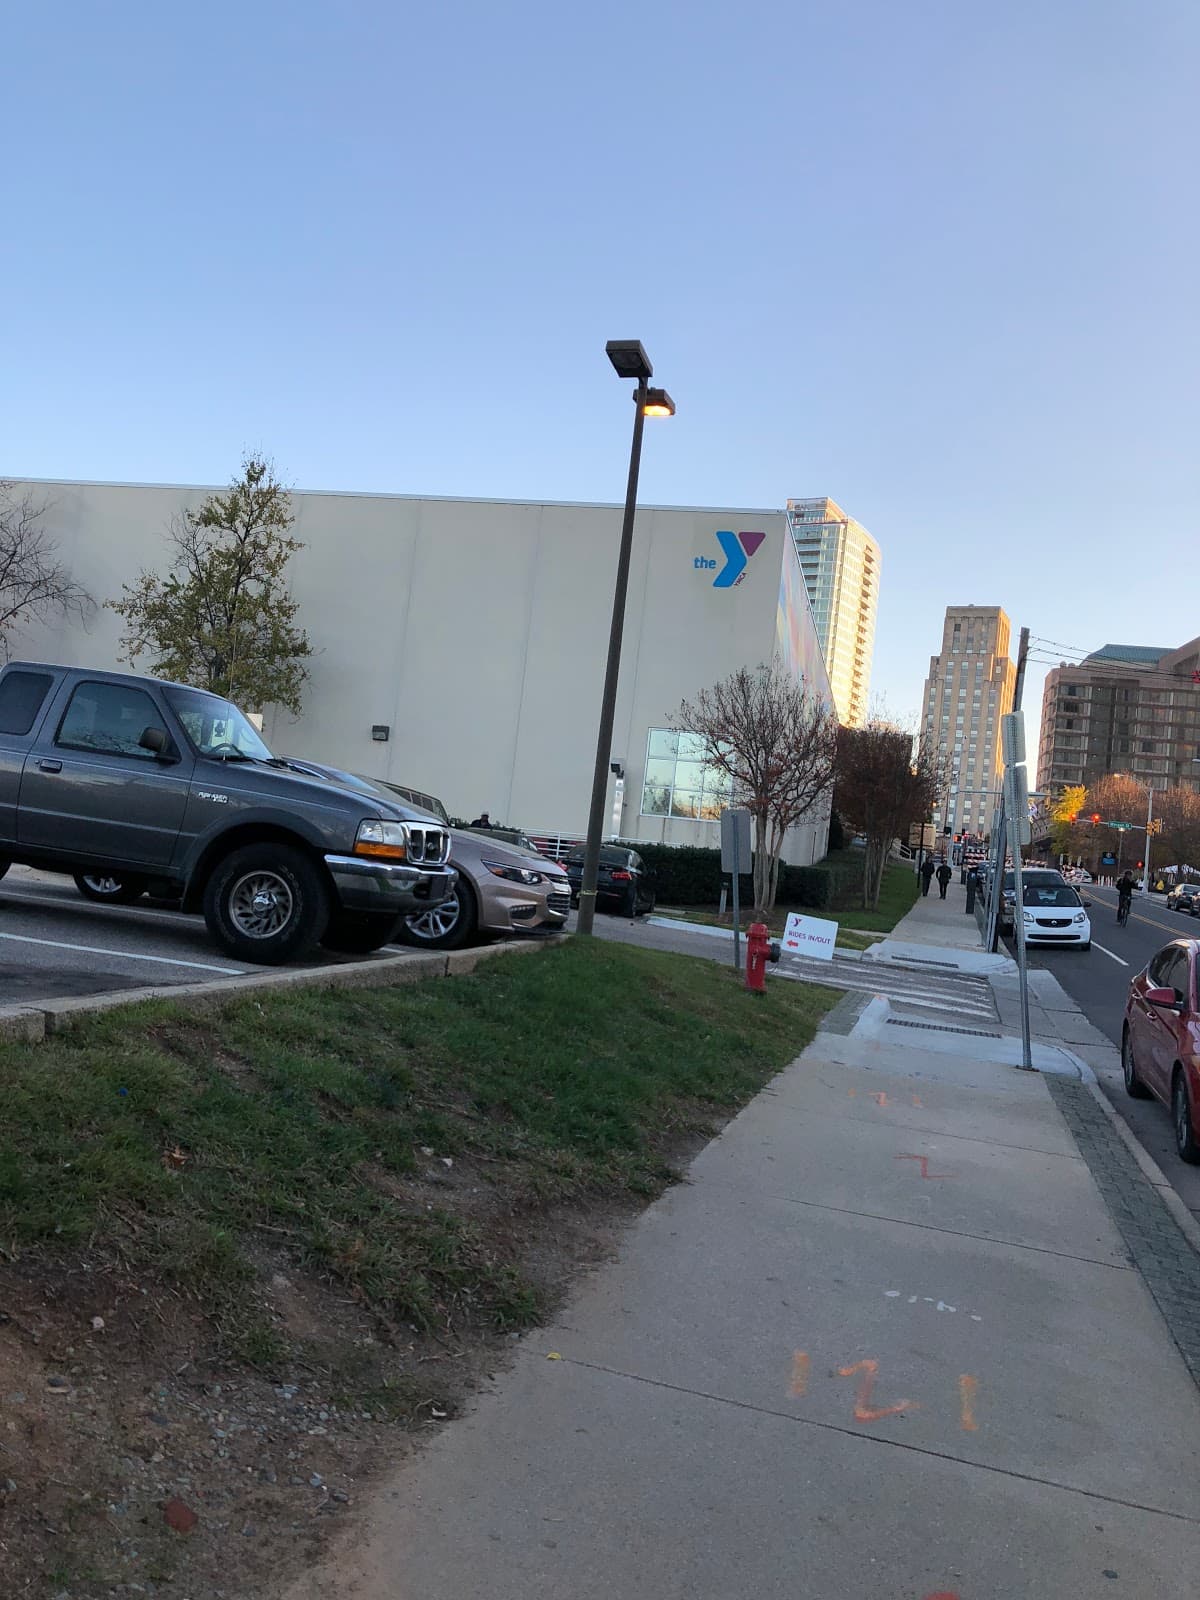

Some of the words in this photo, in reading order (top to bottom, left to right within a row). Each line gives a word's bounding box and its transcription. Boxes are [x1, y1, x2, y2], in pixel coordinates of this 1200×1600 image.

[694, 556, 717, 569] the
[788, 930, 806, 939] RIDES
[808, 935, 831, 944] IN/OUT
